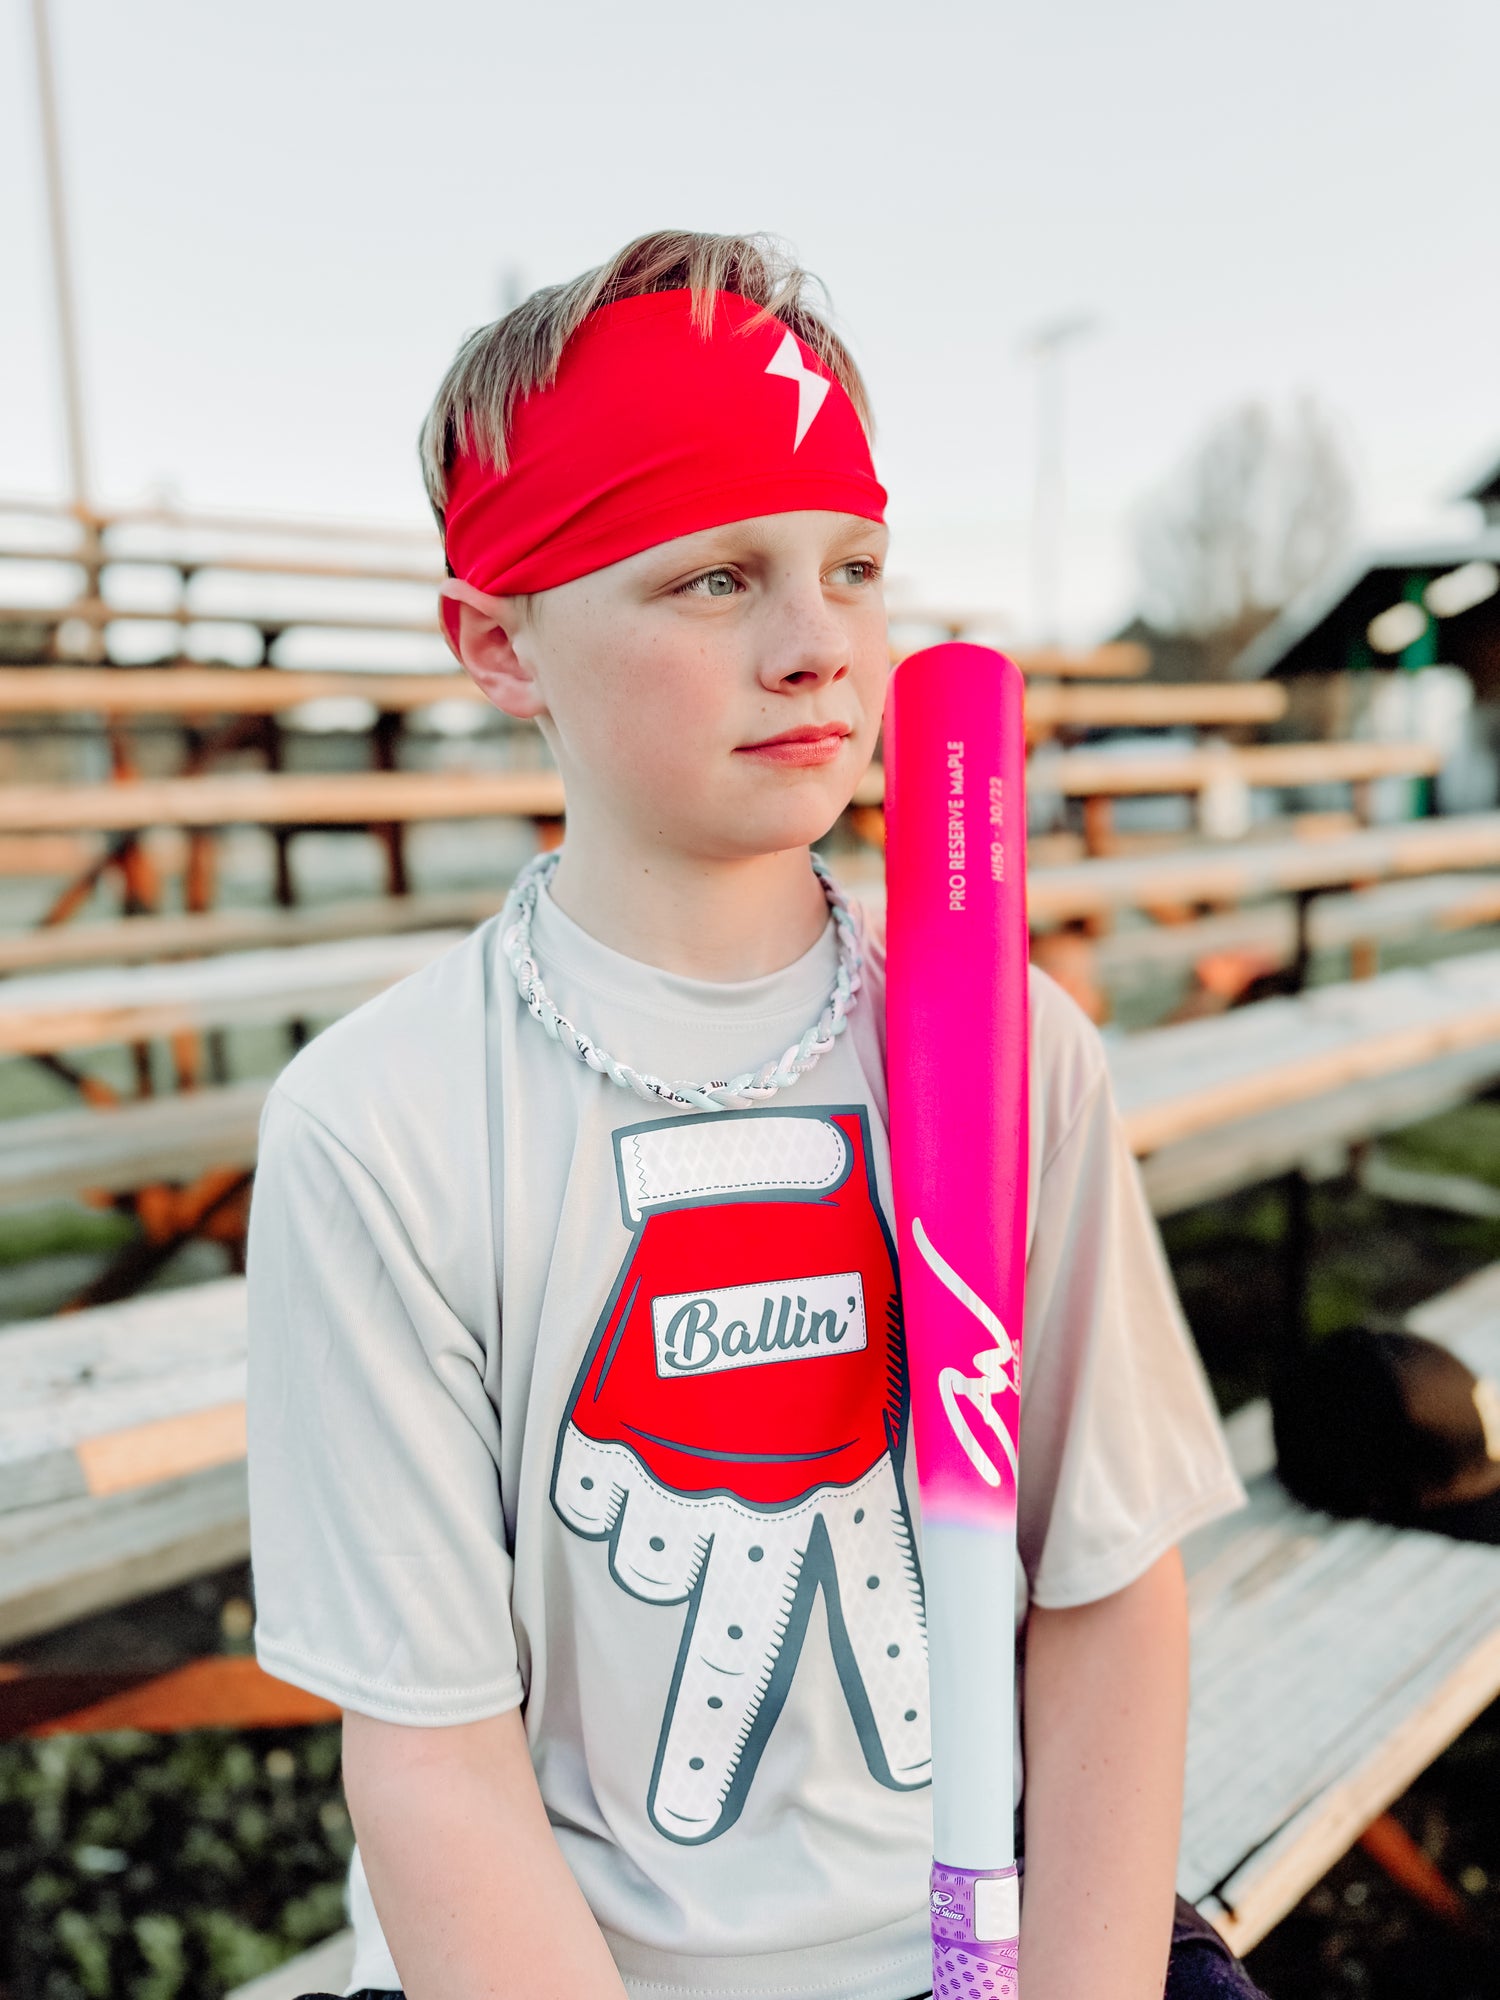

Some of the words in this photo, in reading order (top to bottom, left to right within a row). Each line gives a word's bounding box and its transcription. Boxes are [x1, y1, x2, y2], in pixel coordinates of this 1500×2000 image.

[947, 741, 964, 795] MAPLE
[989, 776, 1004, 826] 30/22
[948, 799, 965, 870] RESERVE
[949, 874, 966, 911] PRO
[664, 1295, 856, 1370] Ballin'
